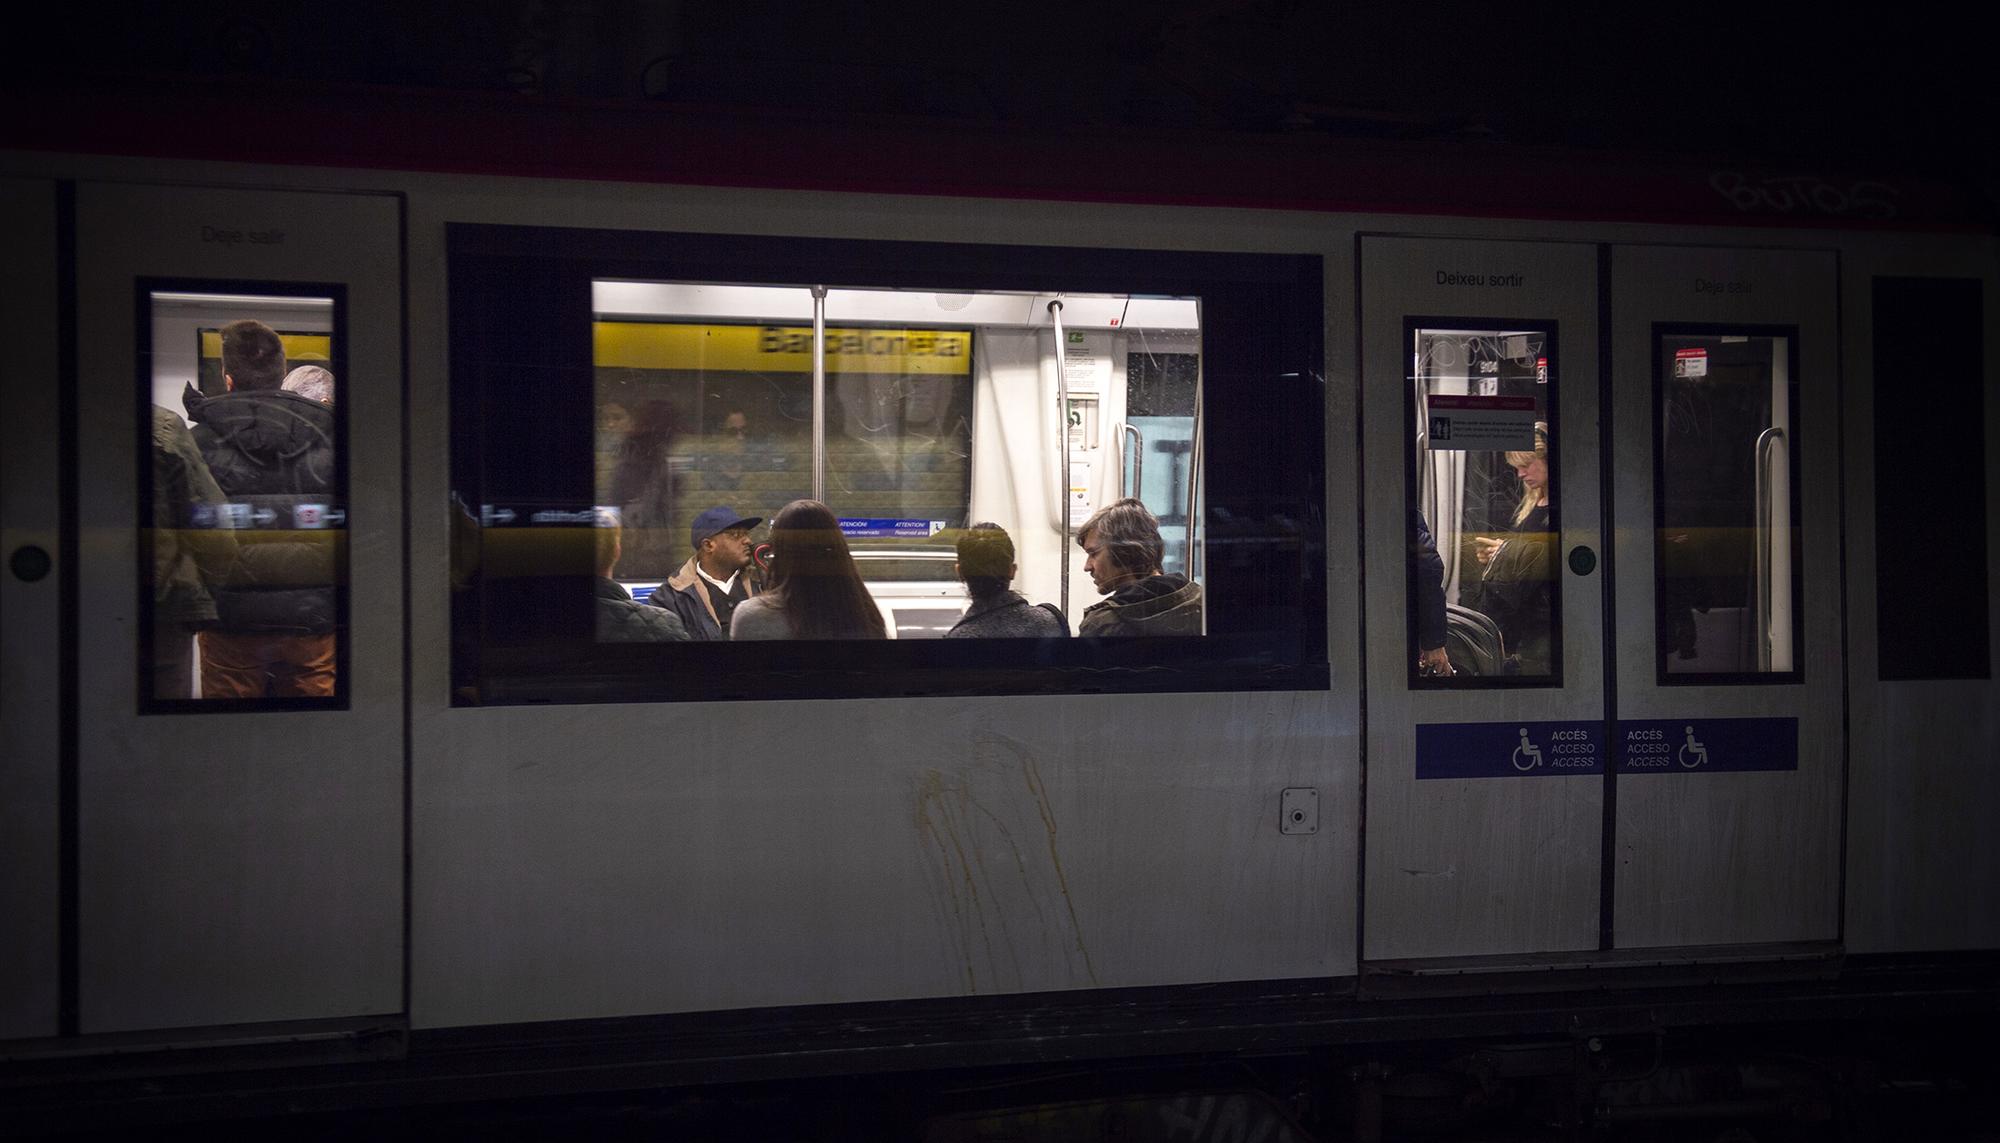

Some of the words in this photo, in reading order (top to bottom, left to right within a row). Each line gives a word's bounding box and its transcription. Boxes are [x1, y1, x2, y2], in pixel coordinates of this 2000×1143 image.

[200, 225, 242, 248] Deje
[1436, 270, 1485, 286] Deixeu
[1489, 273, 1523, 287] sortir
[1695, 278, 1725, 296] Deje
[1552, 729, 1587, 740] ACCÉS
[1627, 729, 1663, 740] ACCÉS
[1552, 743, 1596, 754] ACCESO
[1627, 743, 1670, 753] ACCESO
[1552, 757, 1595, 767] ACCESS
[1627, 757, 1670, 767] ACCESS
